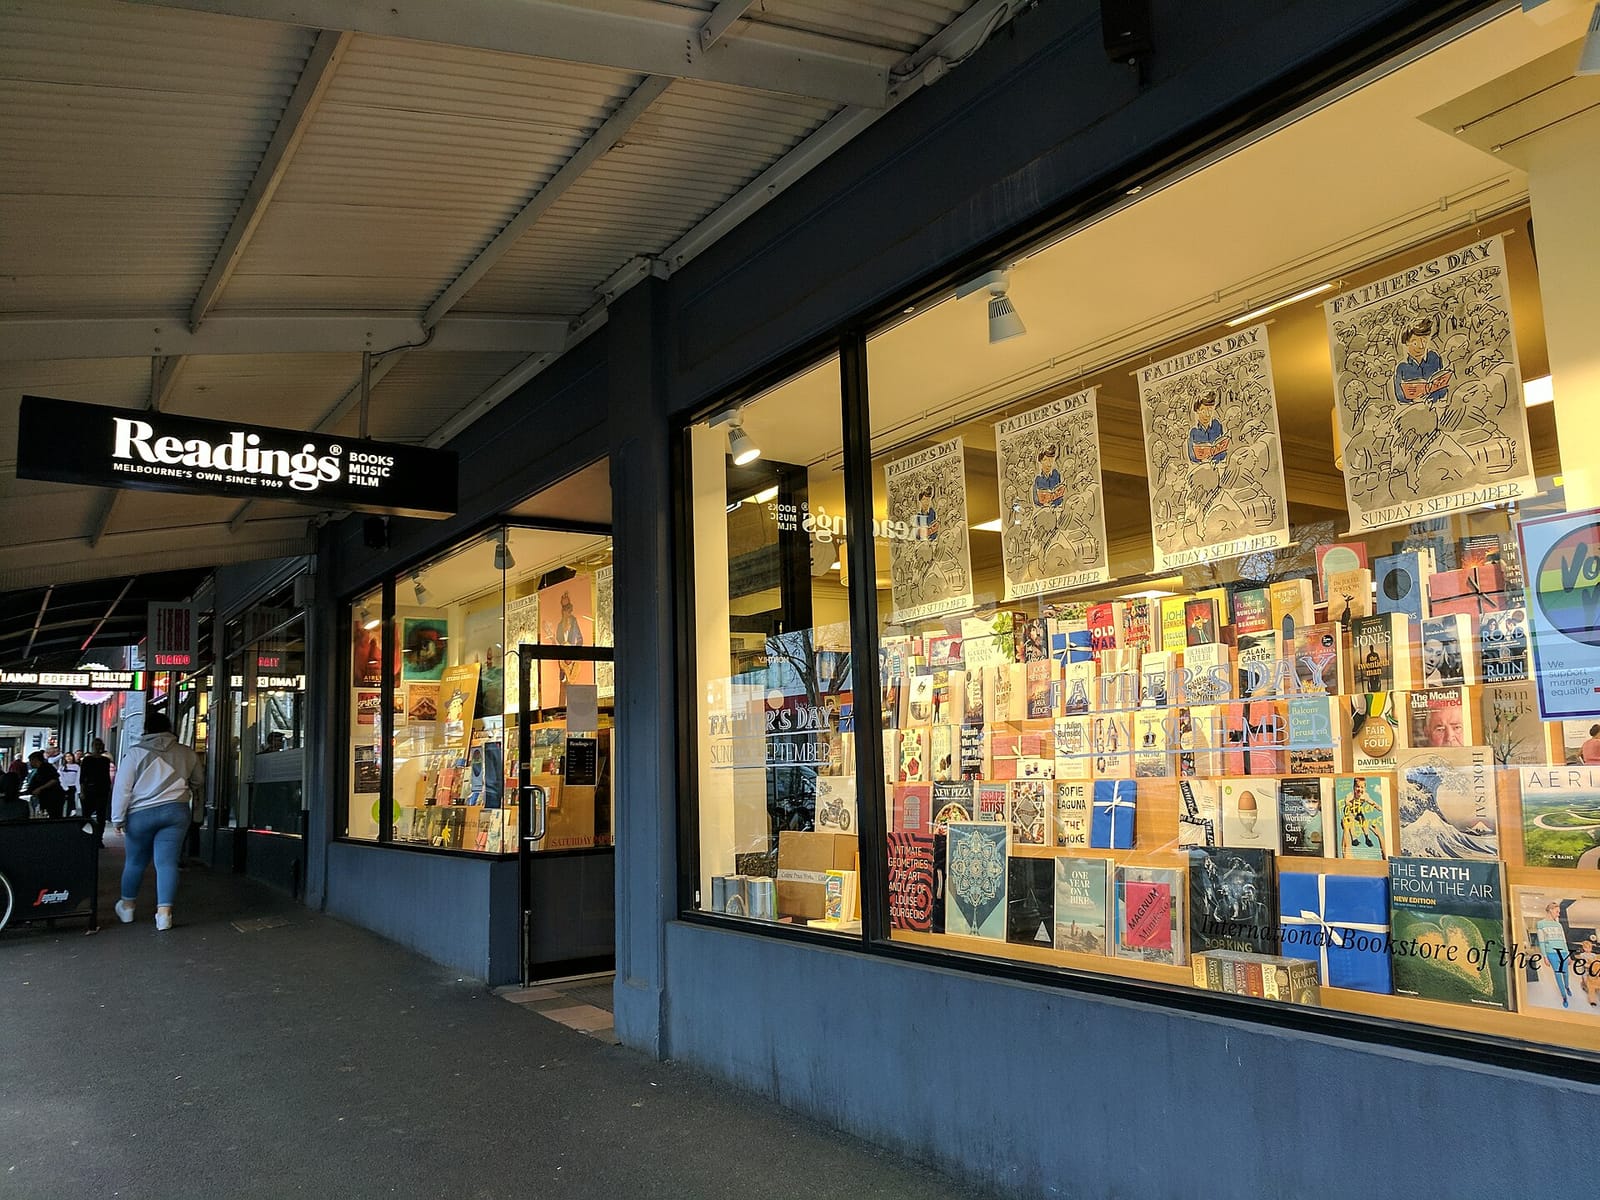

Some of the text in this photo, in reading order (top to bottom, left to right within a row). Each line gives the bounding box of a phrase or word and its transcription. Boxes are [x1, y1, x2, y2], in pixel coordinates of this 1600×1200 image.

[1330, 239, 1493, 315] FATHER'S DAY
[1142, 328, 1260, 383] FATHER'S DAY
[999, 391, 1091, 434] FATHER'S DAY
[112, 417, 341, 491] Readings
[349, 452, 394, 466] BOOKS
[888, 439, 960, 476] FATHER'S DAY
[113, 463, 283, 489] MELBOURNE'S OWN SINCE 1969
[349, 464, 391, 478] MUSIC
[348, 475, 380, 487] FILM
[1361, 505, 1413, 527] SUNDAY
[1416, 503, 1424, 515] 3
[1162, 551, 1201, 569] SUNDAY
[1011, 582, 1040, 597] SUNDAY
[1166, 612, 1185, 622] JOH
[1362, 624, 1383, 635] TONY
[1354, 631, 1392, 648] JONES
[1246, 647, 1266, 656] ALAN
[155, 654, 190, 665] TIAMO
[1242, 654, 1271, 663] CARTER
[1357, 659, 1390, 671] twentieth
[1487, 662, 1523, 677] RUIN
[1547, 661, 1564, 669] We
[1366, 669, 1382, 677] man
[1550, 677, 1595, 688] marriage
[1411, 690, 1459, 701] The Mouth
[1493, 689, 1529, 701] Rain
[1551, 684, 1591, 697] equality
[1411, 699, 1428, 708] that
[1493, 702, 1533, 715] Birds
[1291, 706, 1319, 716] Balcony
[796, 706, 833, 730] DAY
[1292, 718, 1310, 726] Over
[1366, 726, 1386, 735] FAIR
[1364, 739, 1391, 748] FOUL
[760, 742, 830, 762] EPTEMBER
[1381, 757, 1397, 765] HILL
[1472, 752, 1486, 818] HOKUSAI
[951, 787, 971, 797] PIZZA
[1059, 786, 1084, 797] SOFIE
[980, 801, 1005, 812] ARTIST
[1057, 799, 1087, 810] LAGUNA
[1285, 814, 1313, 824] Working
[1064, 820, 1081, 830] THE
[1285, 824, 1301, 832] Class
[1286, 834, 1299, 844] Boy
[895, 846, 922, 856] INTIMATE
[888, 858, 929, 868] GEOMETRIES
[895, 870, 921, 881] THE ART
[1071, 871, 1089, 880] ONE
[1390, 863, 1470, 881] THE EARTH
[888, 883, 926, 894] AND LIFE OF
[1069, 879, 1090, 888] YEAR
[1392, 878, 1494, 899] FROM THE AIR
[1070, 887, 1090, 897] ON A
[895, 895, 918, 906] LOUISE
[1070, 896, 1090, 905] BIKE
[1393, 895, 1437, 905] NEW EDITION
[890, 907, 925, 919] BOURGEOIS
[1128, 887, 1160, 931] MAGNUM
[1138, 902, 1169, 941] Manifesto
[1201, 914, 1335, 947] International
[1342, 927, 1459, 962] Bookstore
[1467, 939, 1495, 971] of
[1500, 943, 1542, 971] the
[1205, 938, 1253, 953] BOB KING
